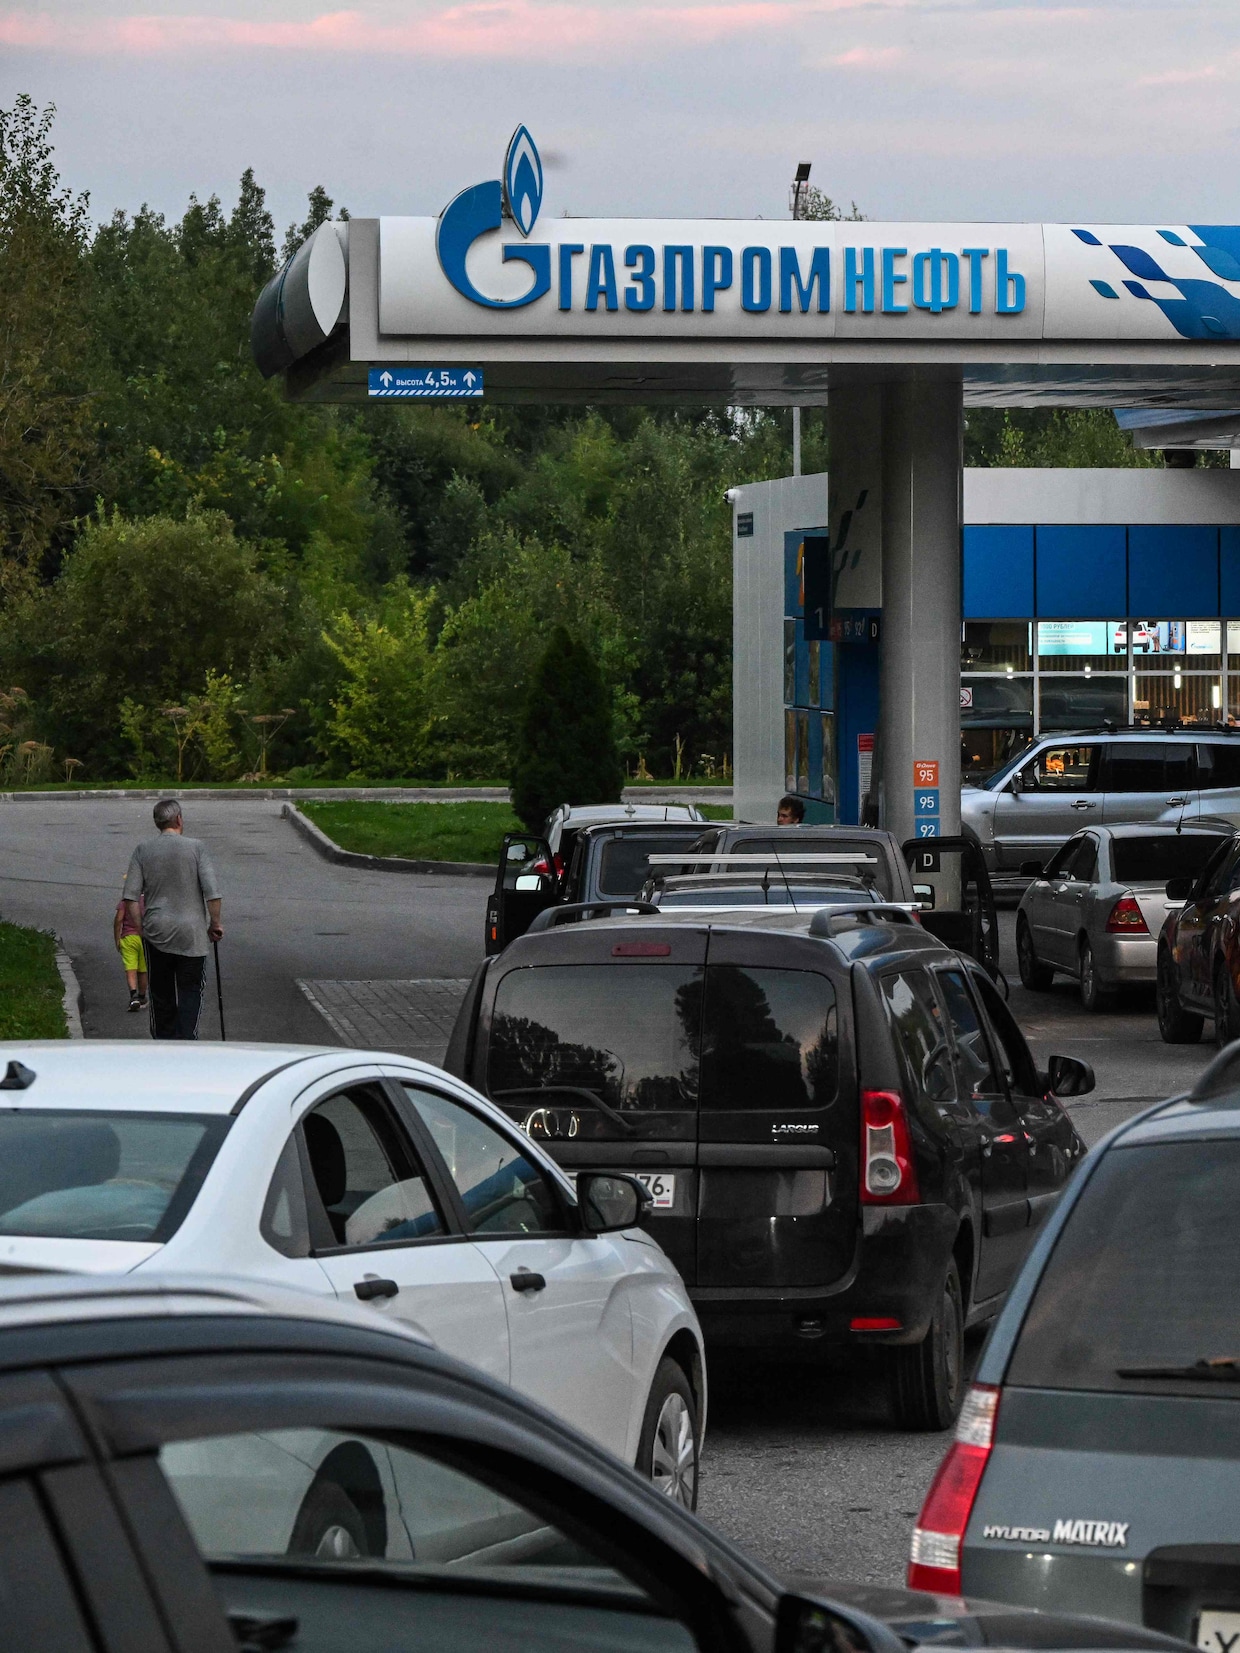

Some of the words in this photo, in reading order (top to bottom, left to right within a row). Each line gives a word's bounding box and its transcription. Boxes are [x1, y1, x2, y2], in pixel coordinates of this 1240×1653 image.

[558, 244, 830, 313] ГАЗПРОМ
[843, 247, 1026, 313] НЕФТЬ
[814, 607, 824, 629] 1
[871, 623, 878, 638] D
[919, 770, 934, 781] 95
[919, 796, 935, 809] 95
[920, 825, 935, 837] 92
[923, 853, 934, 866] D
[771, 1124, 820, 1134] LARGUS
[983, 1525, 1050, 1542] HYUNDAI
[1053, 1518, 1129, 1547] MATRIX
